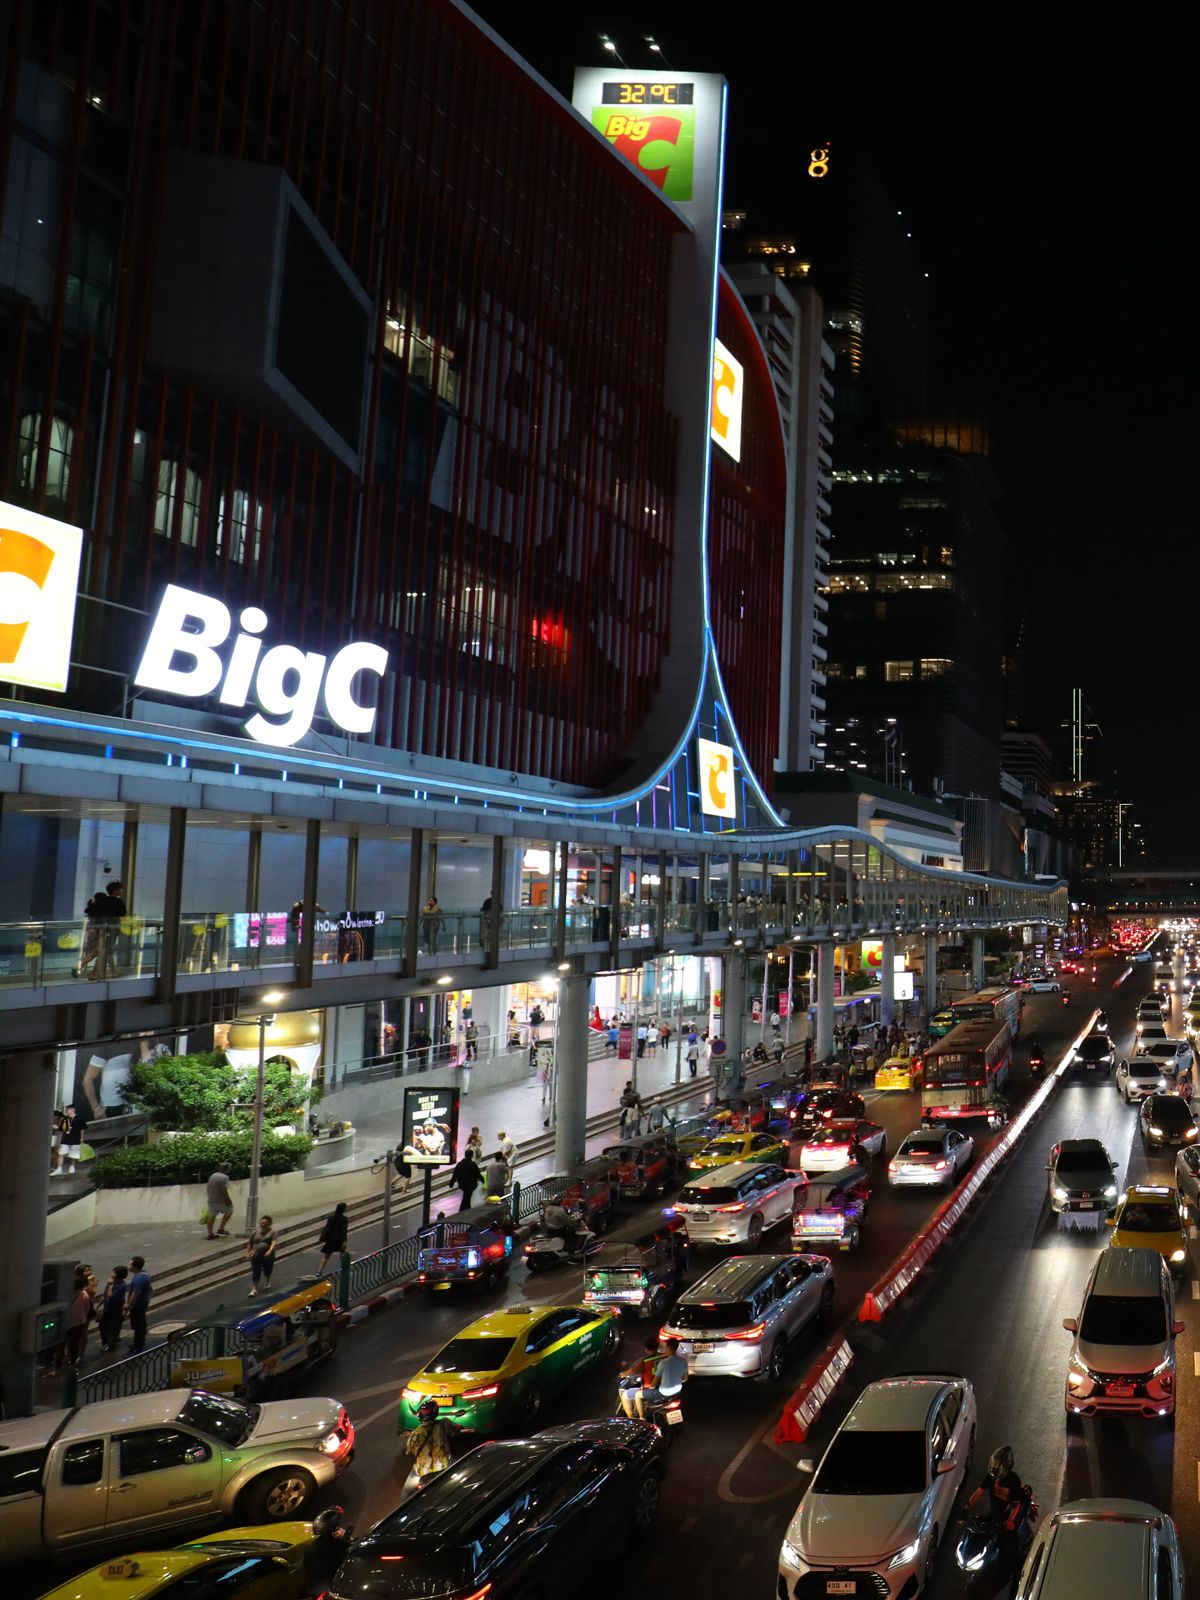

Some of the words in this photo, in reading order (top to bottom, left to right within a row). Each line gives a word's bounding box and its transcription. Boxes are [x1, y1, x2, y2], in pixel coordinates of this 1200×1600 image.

[619, 84, 645, 103] 32
[605, 115, 650, 140] Big
[437, 1256, 456, 1264] Tops
